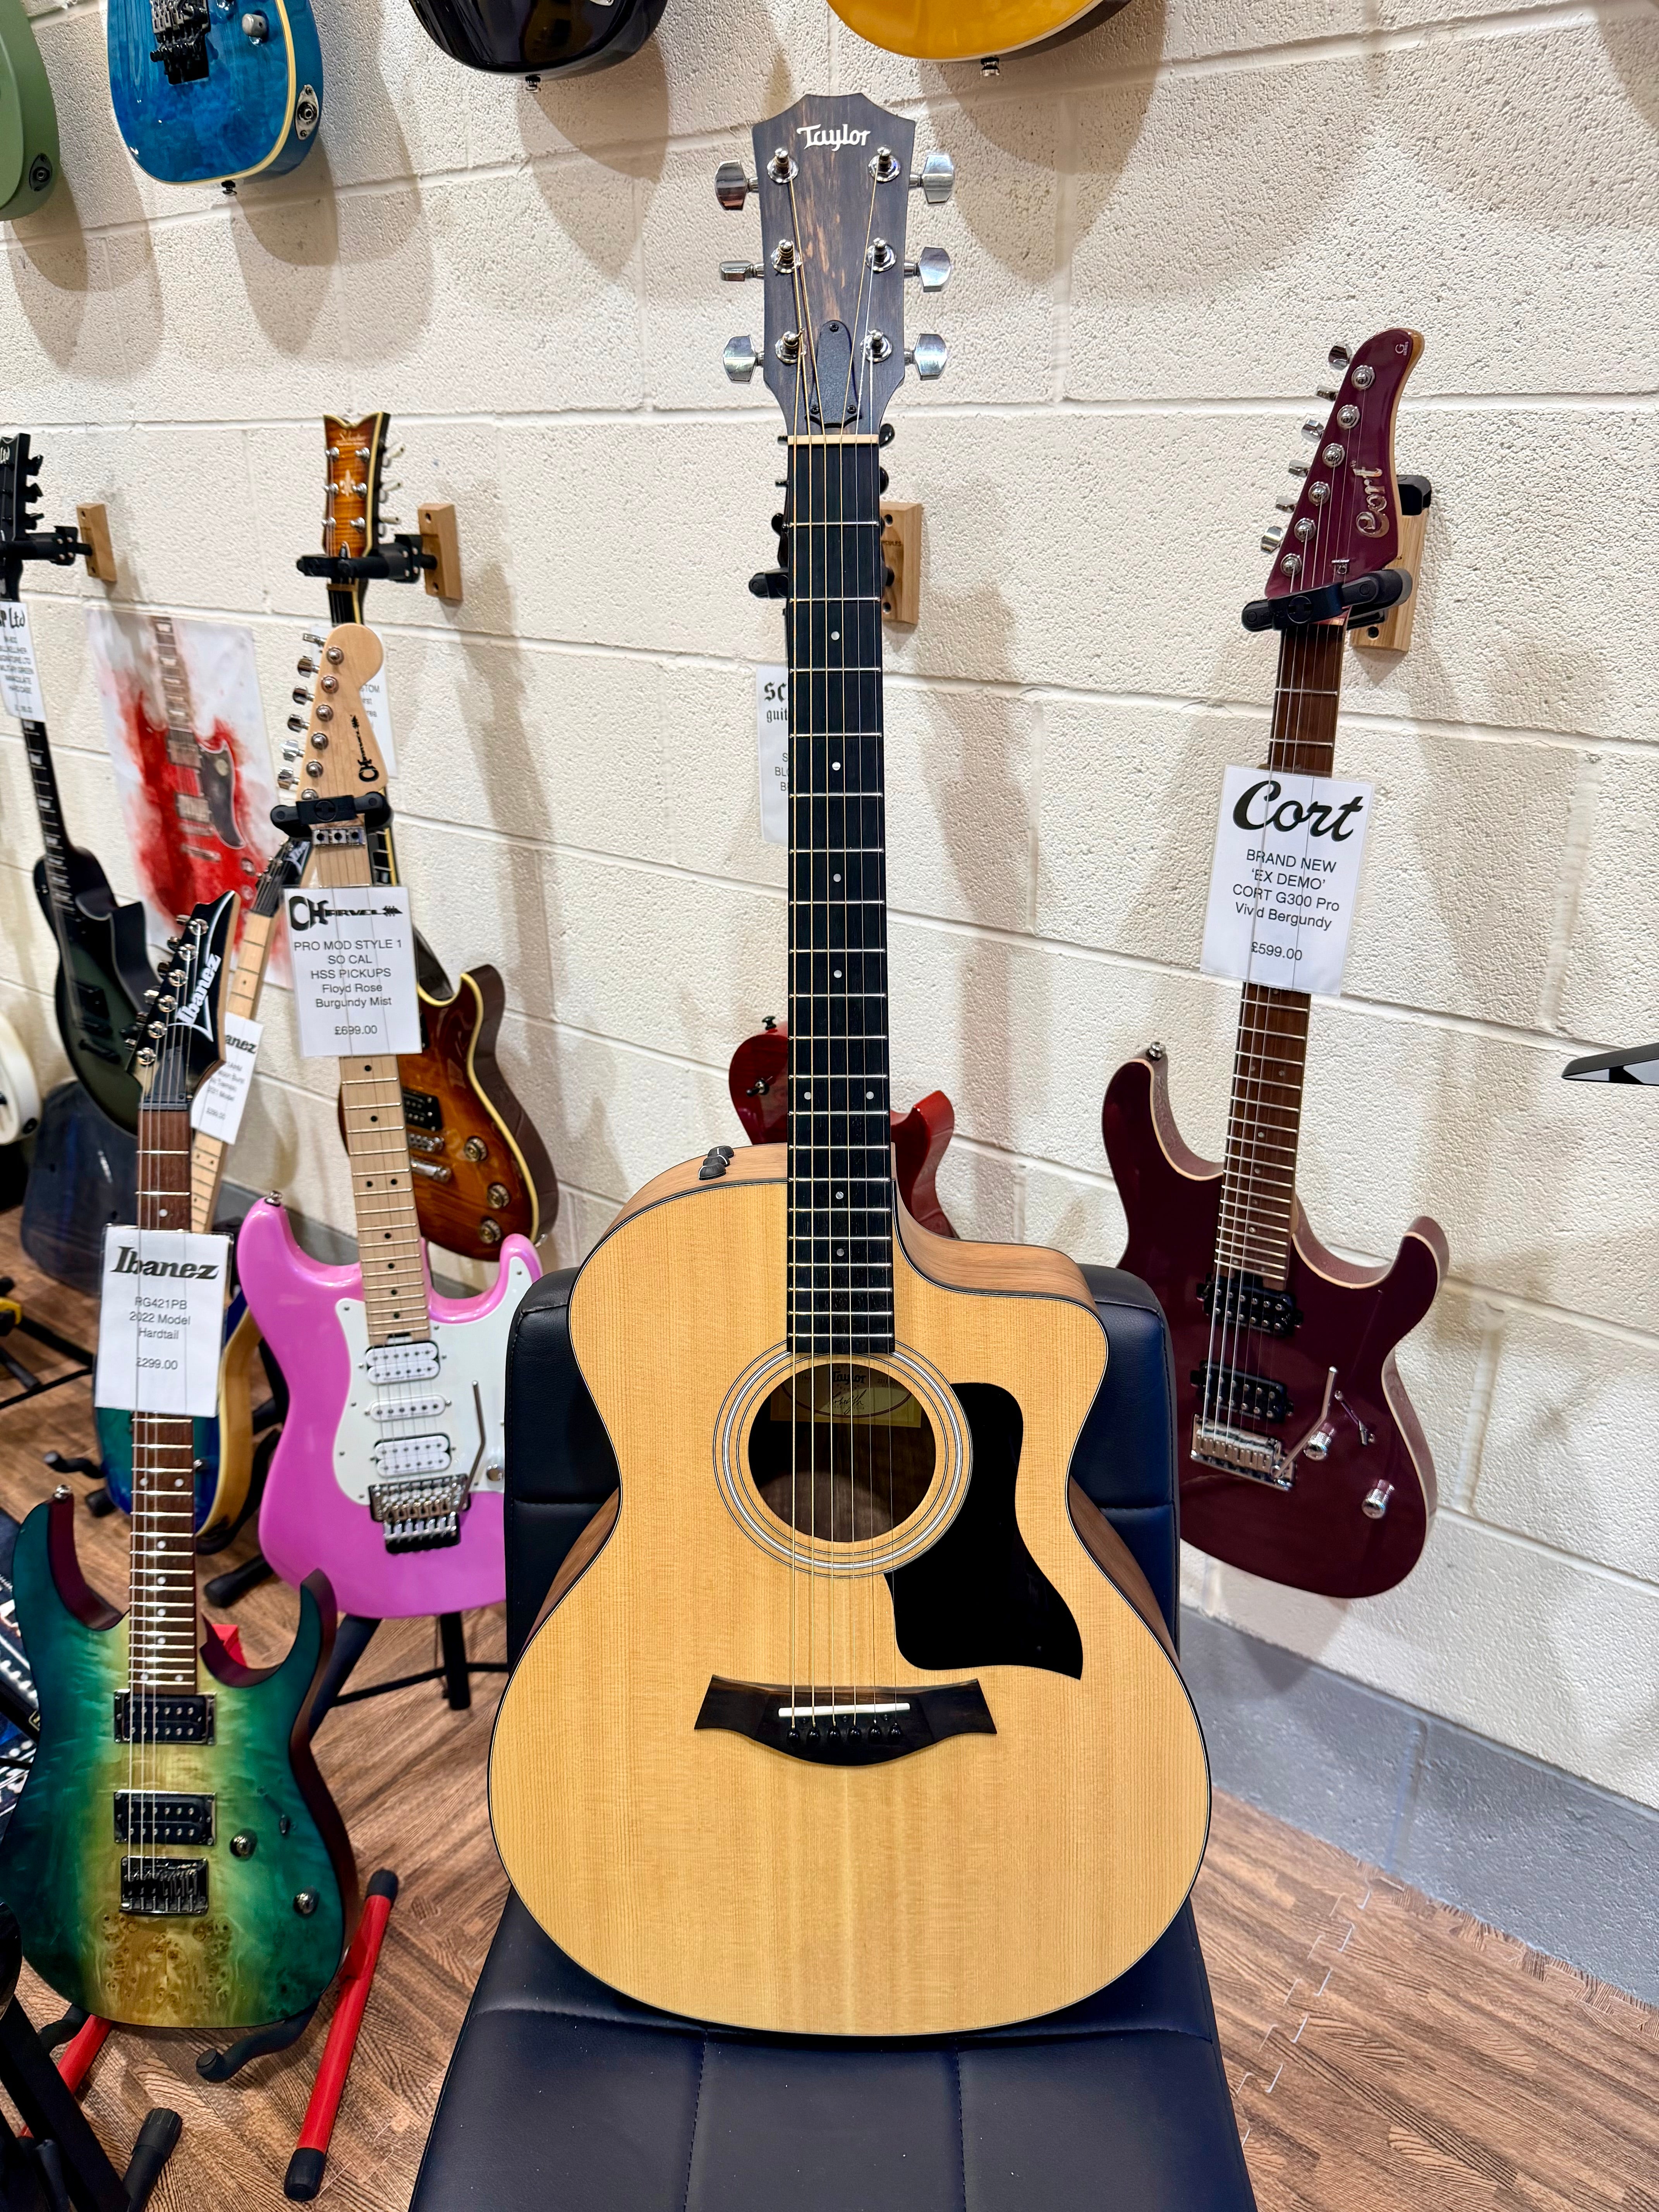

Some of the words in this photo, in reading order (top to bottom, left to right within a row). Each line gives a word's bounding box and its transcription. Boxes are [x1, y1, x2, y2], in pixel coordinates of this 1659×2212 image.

[796, 124, 871, 151] Taylor
[1353, 467, 1389, 538] Cort
[360, 685, 380, 693] STOM
[1233, 780, 1363, 842] Cort
[1246, 849, 1296, 867] BRAND
[1301, 858, 1336, 873] NEW
[1233, 884, 1273, 901] CORT
[1276, 892, 1312, 907] G300
[1317, 899, 1340, 912] Pro
[1235, 902, 1264, 918] Vivd
[1268, 909, 1332, 931] Bergundy
[294, 941, 320, 951] PRO
[324, 940, 351, 950] MOD
[355, 939, 393, 950] STYLE
[397, 939, 402, 948] 1
[1251, 941, 1302, 960] £599.00
[328, 955, 345, 964] SO
[349, 955, 372, 964] CAL
[311, 970, 336, 979] HSS
[340, 969, 392, 978] PICKUPS
[176, 953, 222, 1025] Ibanez
[322, 985, 352, 994] Floyd
[356, 984, 383, 992] Rose
[316, 998, 366, 1009] Burgundy
[370, 997, 392, 1006] Mist
[335, 1025, 378, 1035] £699.00
[225, 1035, 256, 1054] anez
[110, 1246, 220, 1280] Ibanez
[135, 1297, 187, 1310] RG421PB
[158, 1315, 191, 1325] Model
[138, 1327, 179, 1340] Hardtail
[832, 1370, 866, 1385] Taylor
